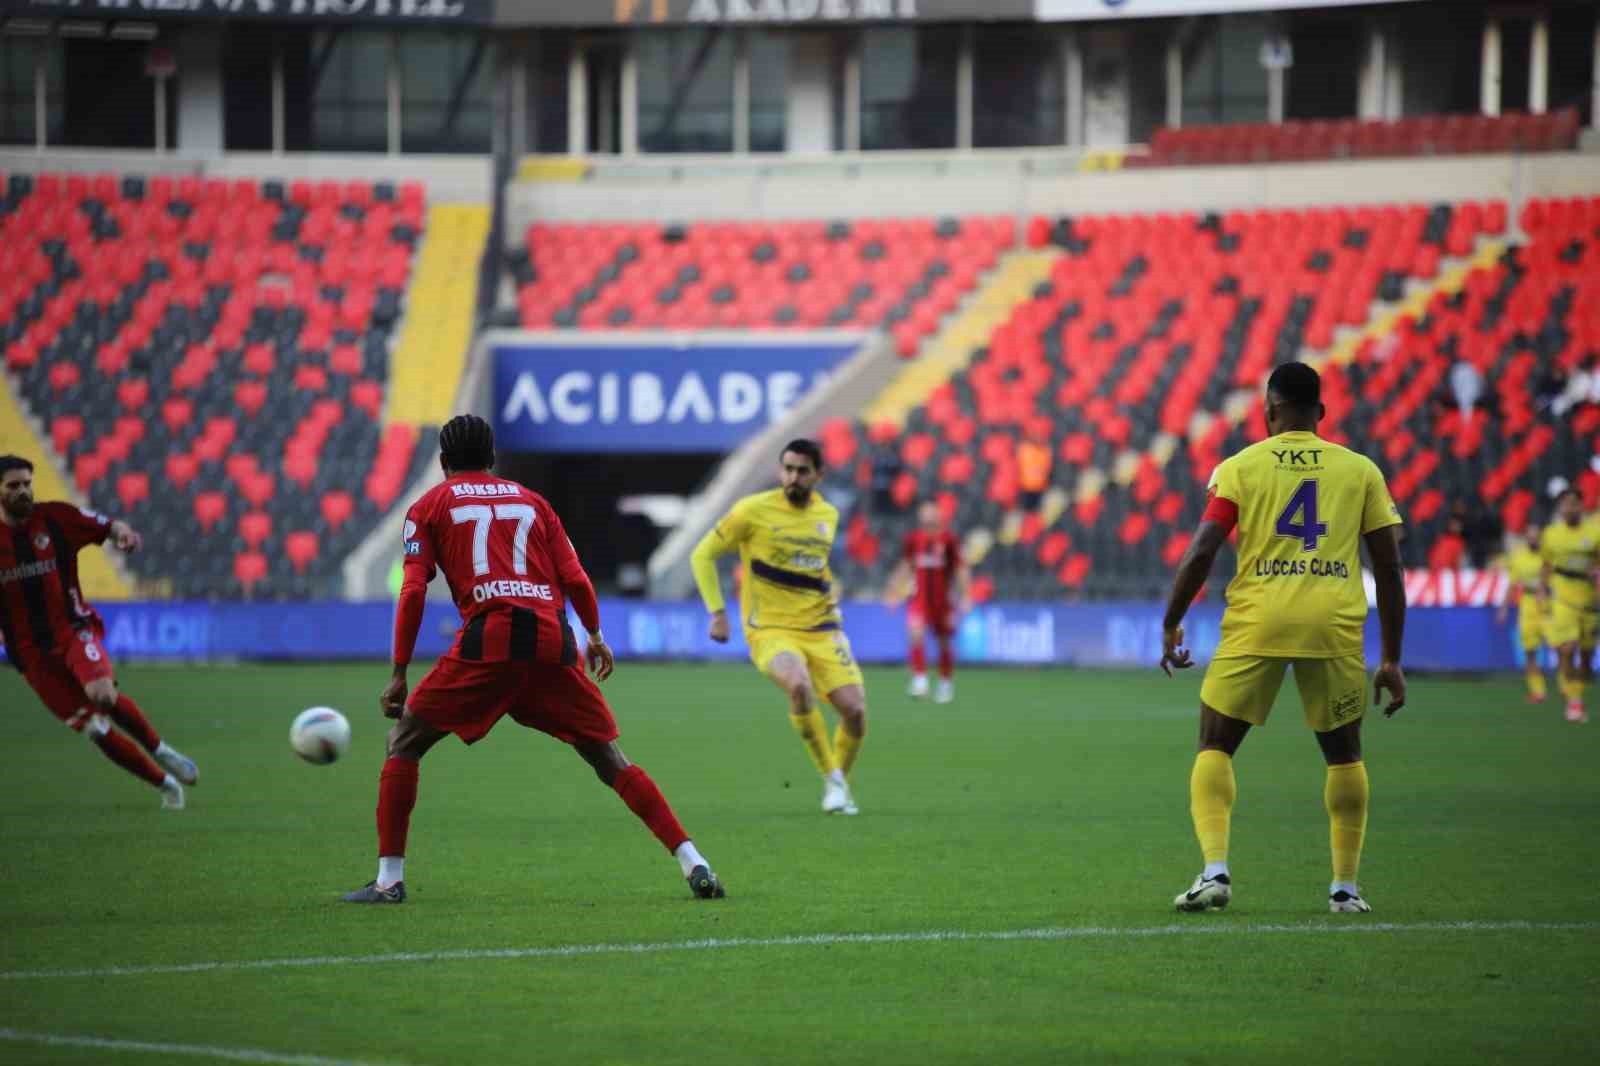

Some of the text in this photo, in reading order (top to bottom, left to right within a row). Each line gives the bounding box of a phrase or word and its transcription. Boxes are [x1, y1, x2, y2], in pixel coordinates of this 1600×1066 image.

[503, 370, 827, 424] ACIBADE
[1271, 449, 1323, 465] YKT
[1275, 478, 1329, 553] 4
[450, 503, 537, 577] 77
[1256, 558, 1349, 579] LUCCAS CLARO
[473, 581, 553, 603] OKEREKE
